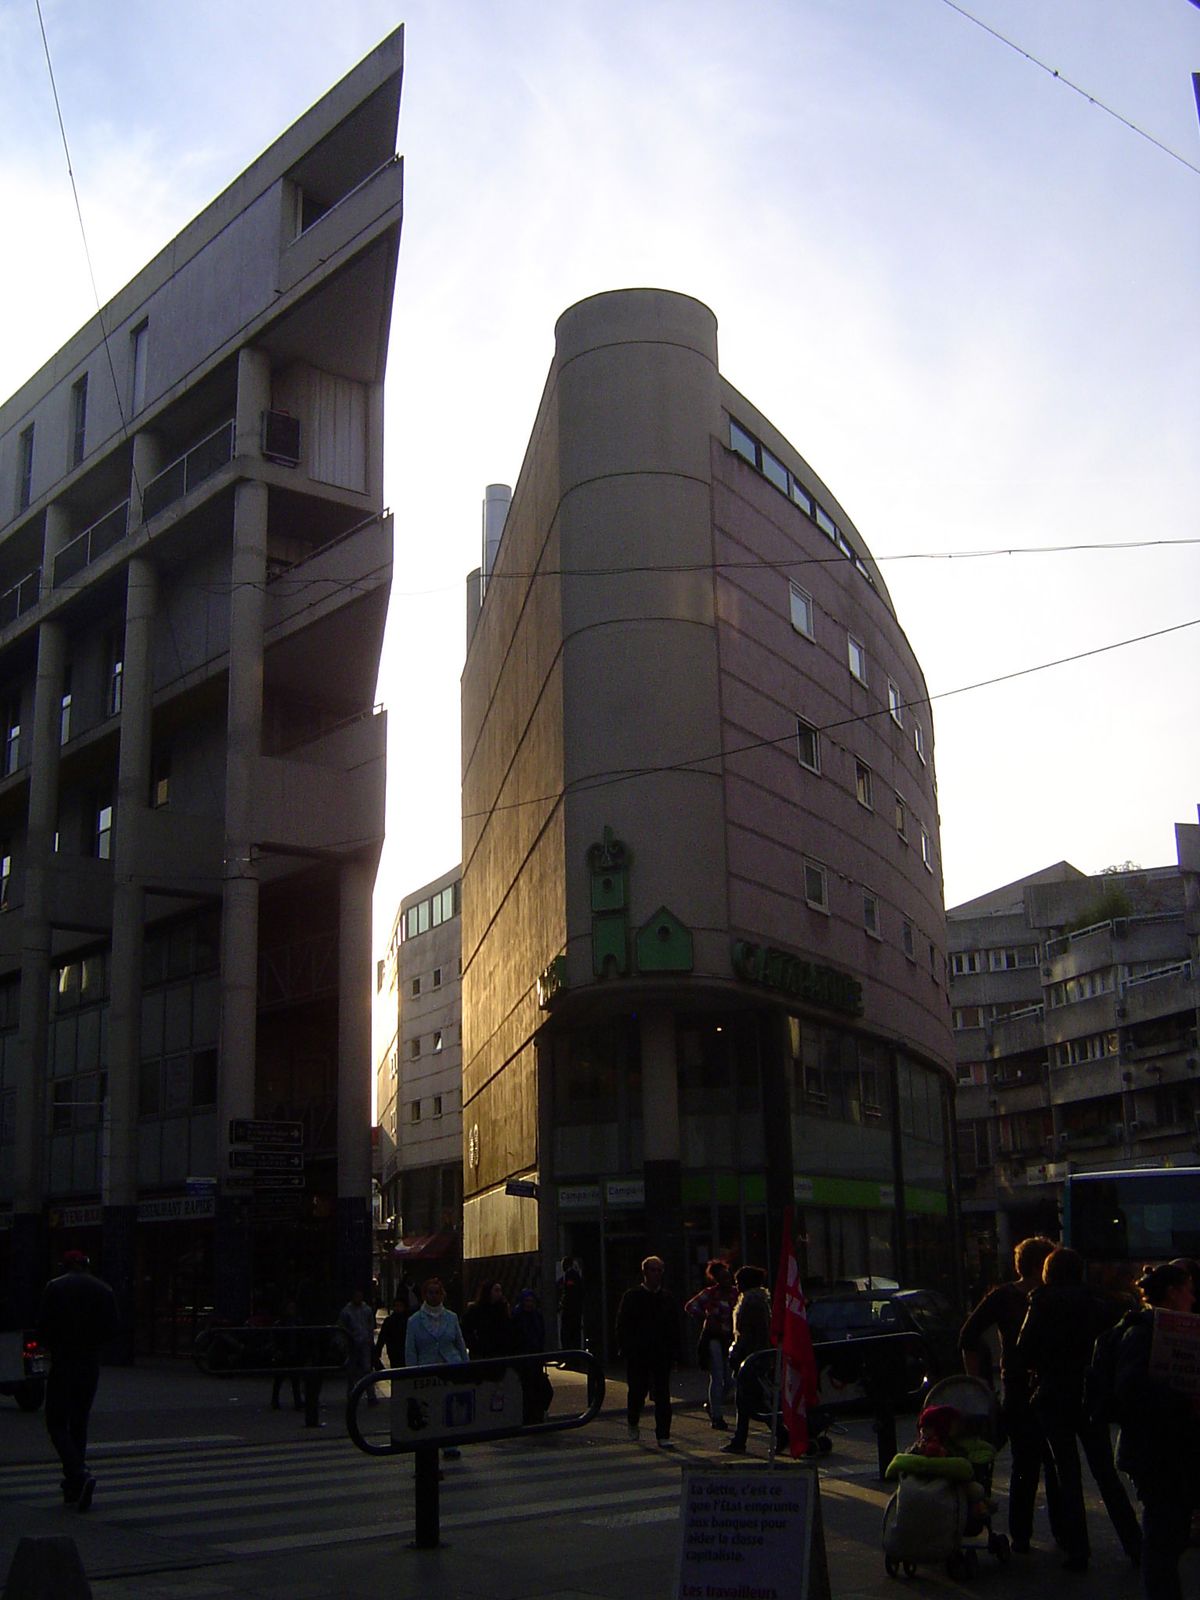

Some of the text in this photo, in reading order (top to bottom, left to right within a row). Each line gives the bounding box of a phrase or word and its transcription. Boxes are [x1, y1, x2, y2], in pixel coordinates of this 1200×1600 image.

[691, 1484, 703, 1495] La
[742, 1484, 767, 1495] c'est
[769, 1486, 782, 1496] ce
[690, 1502, 711, 1513] que
[744, 1502, 800, 1514] emprunte
[689, 1516, 787, 1532] aux banques pour
[687, 1533, 764, 1545] aider la classe
[686, 1550, 745, 1563] capitaliste.
[682, 1585, 777, 1599] Les travailleurs
